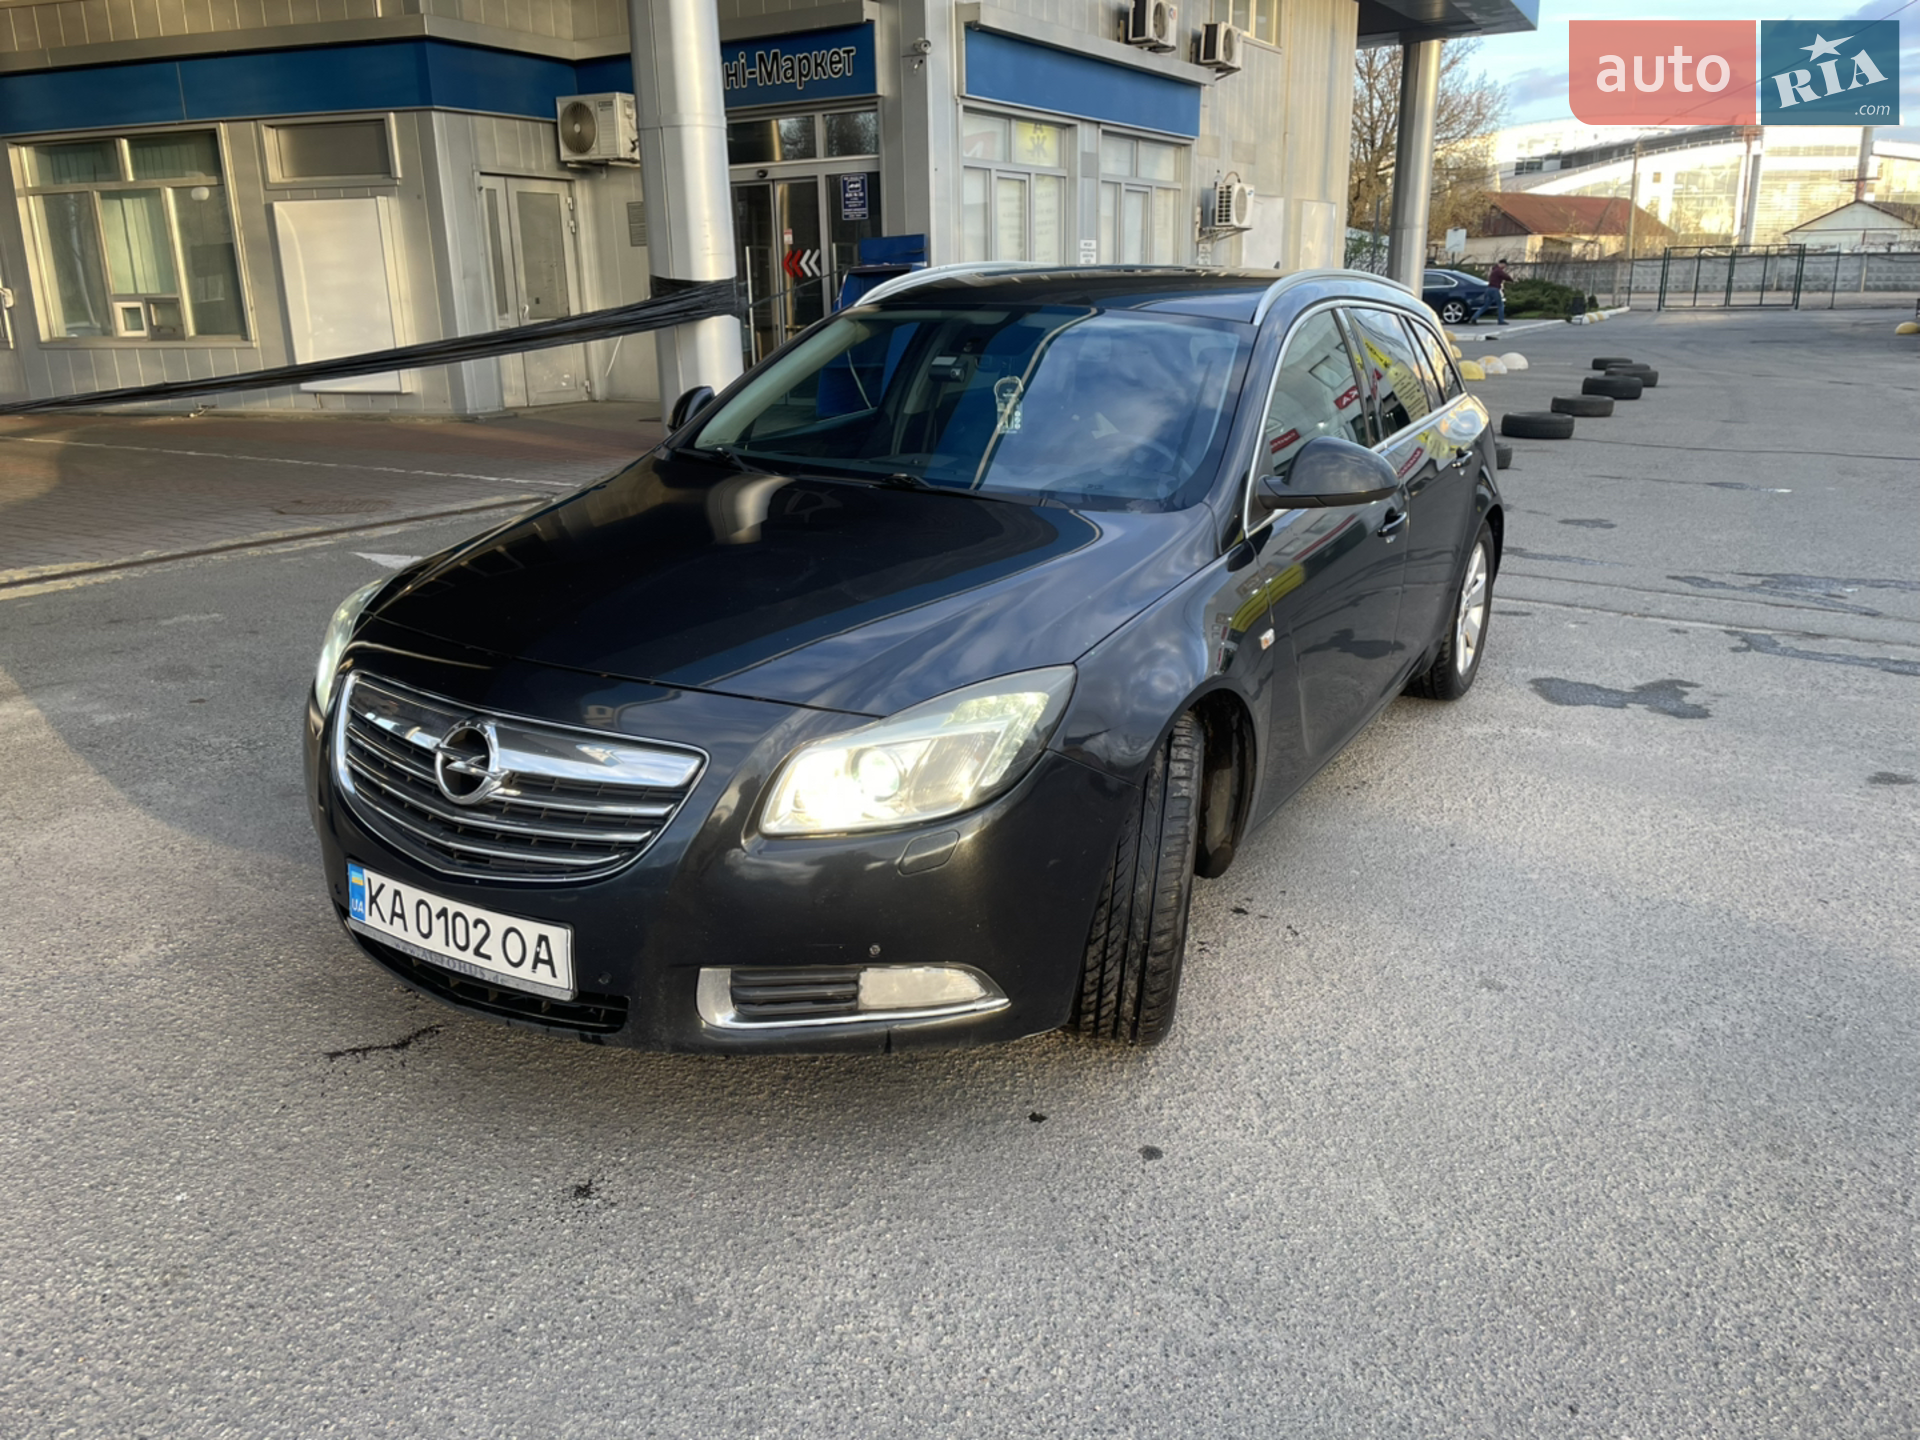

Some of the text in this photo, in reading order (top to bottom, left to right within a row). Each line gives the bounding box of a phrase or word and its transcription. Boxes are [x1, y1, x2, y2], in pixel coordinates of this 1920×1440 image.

[722, 46, 857, 90] ні-Маркет
[351, 897, 365, 915] UA
[415, 898, 492, 961] 0102
